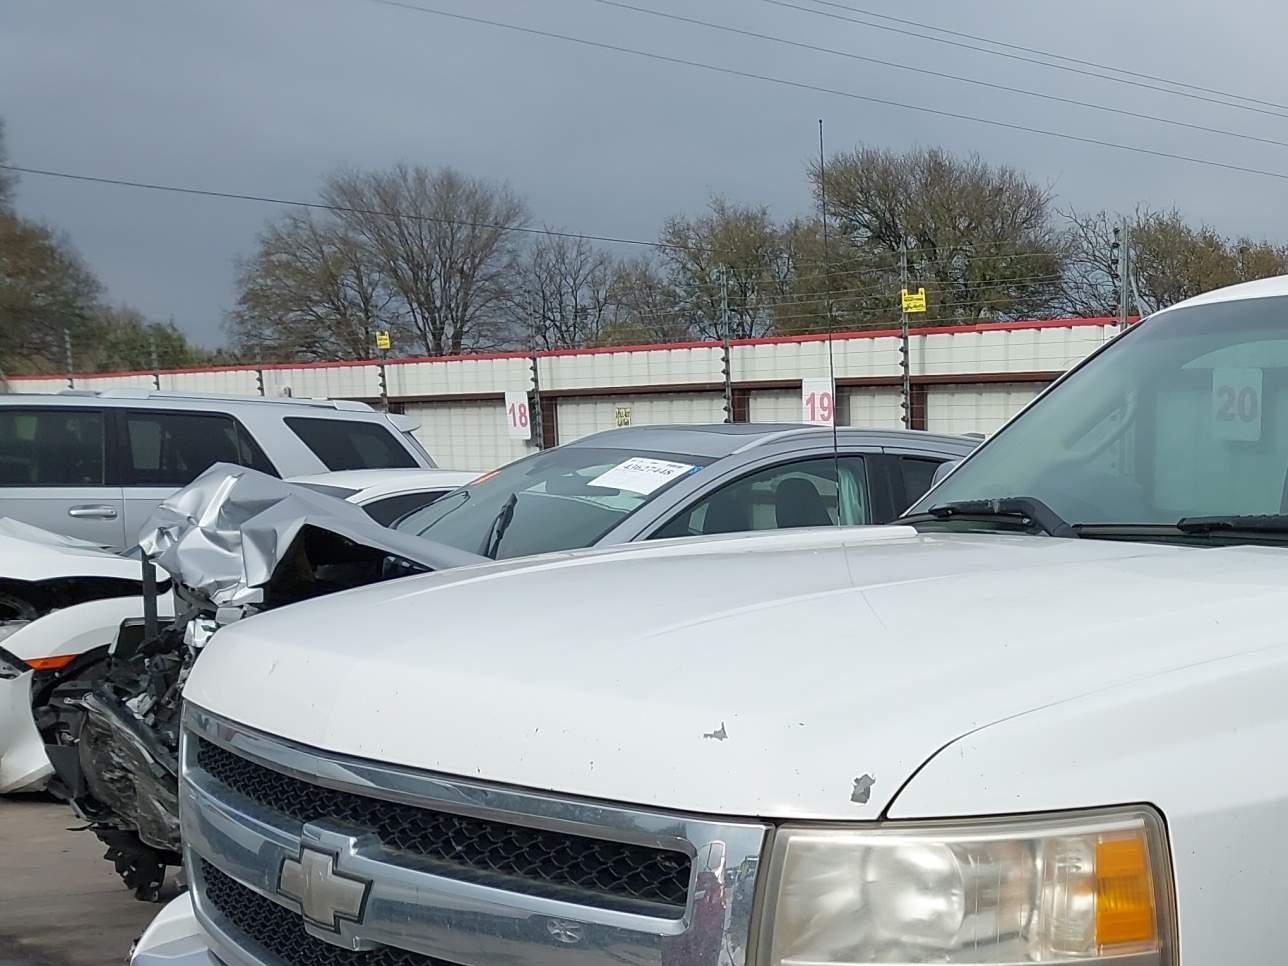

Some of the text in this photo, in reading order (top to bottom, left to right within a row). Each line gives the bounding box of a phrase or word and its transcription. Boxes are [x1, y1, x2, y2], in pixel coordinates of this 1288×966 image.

[508, 402, 529, 428] 18
[805, 391, 833, 422] 19
[1216, 384, 1258, 423] 20
